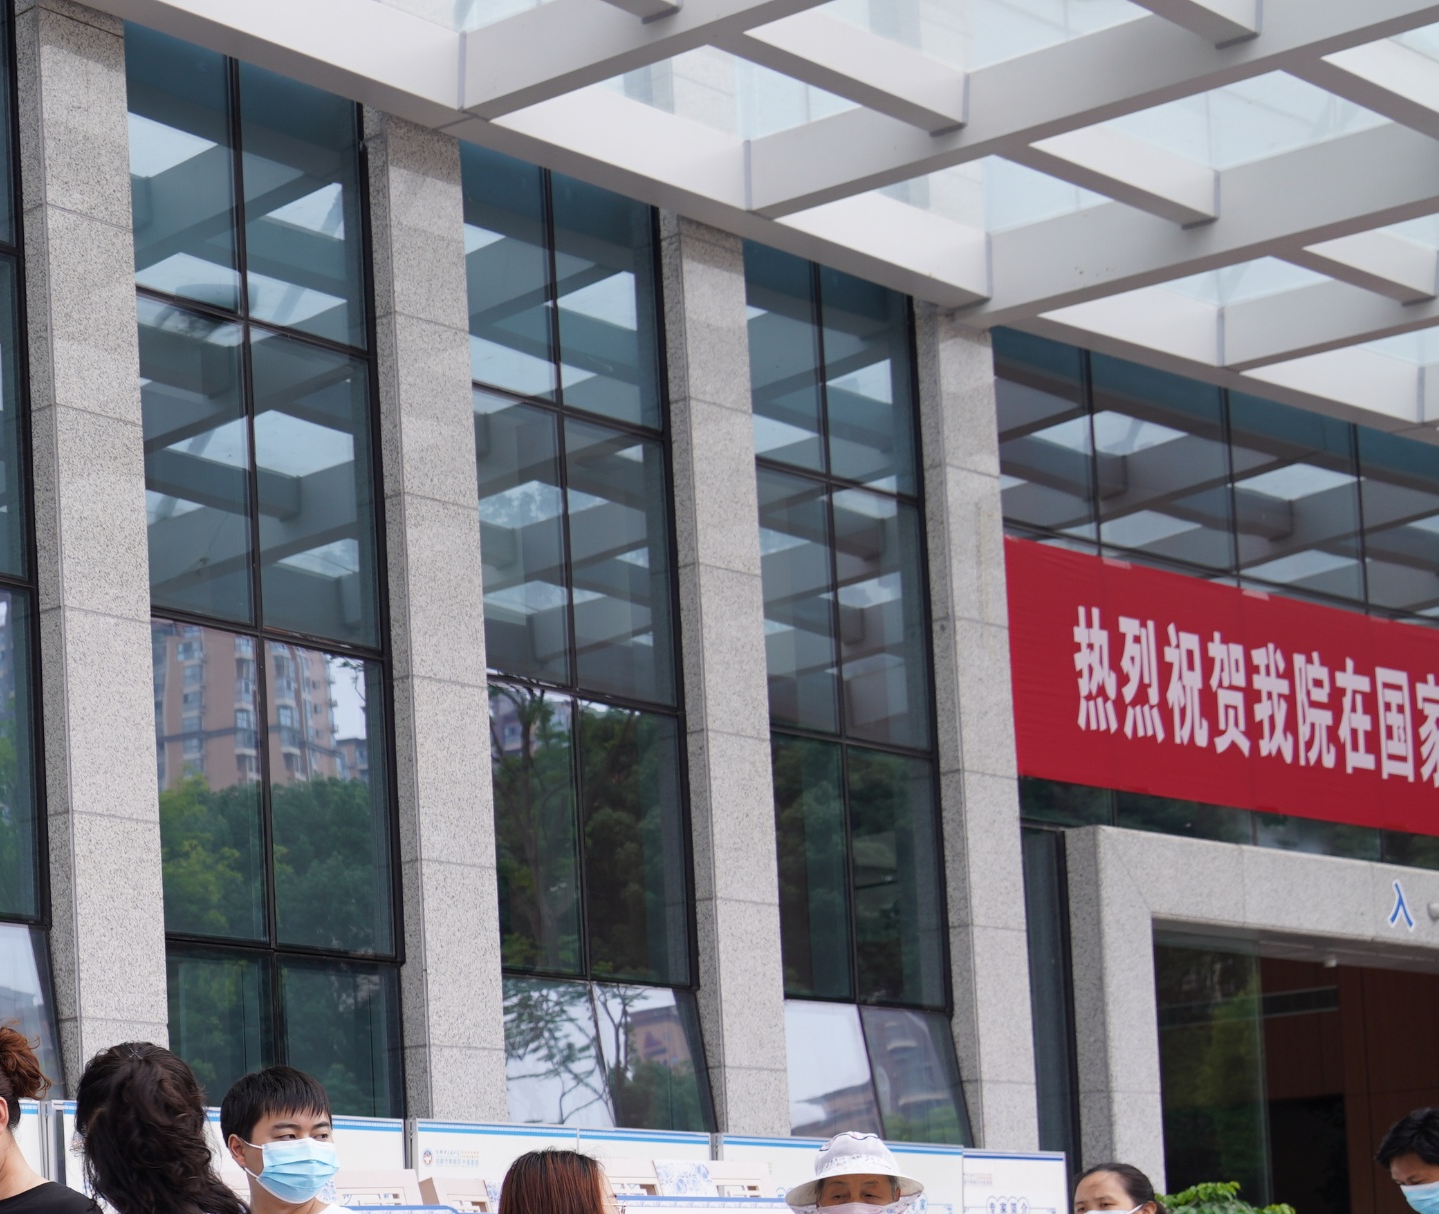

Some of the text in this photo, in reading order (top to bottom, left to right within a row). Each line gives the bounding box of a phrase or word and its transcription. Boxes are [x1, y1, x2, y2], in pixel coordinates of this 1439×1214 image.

[1072, 605, 1439, 788] 热烈祝贺我院在国家
[1388, 880, 1414, 931] 入
[988, 1203, 1029, 1214] 专家简介
